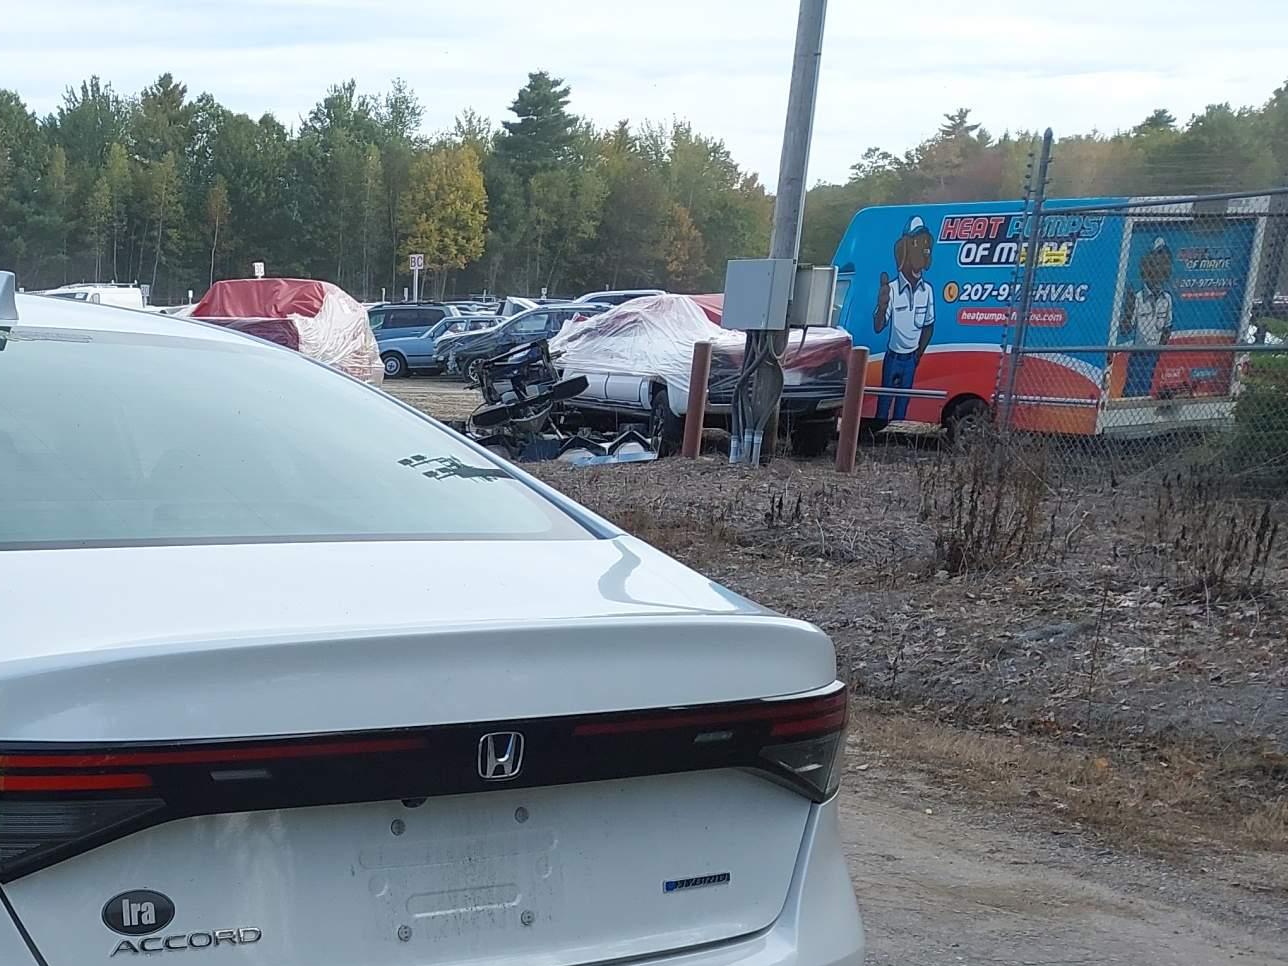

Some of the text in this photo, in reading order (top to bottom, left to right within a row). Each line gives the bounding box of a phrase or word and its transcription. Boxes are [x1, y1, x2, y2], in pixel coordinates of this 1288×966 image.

[941, 216, 1005, 240] HEAT
[410, 256, 423, 268] BC
[960, 242, 990, 263] OF
[122, 898, 157, 927] Ira
[110, 927, 263, 958] ACCORD
